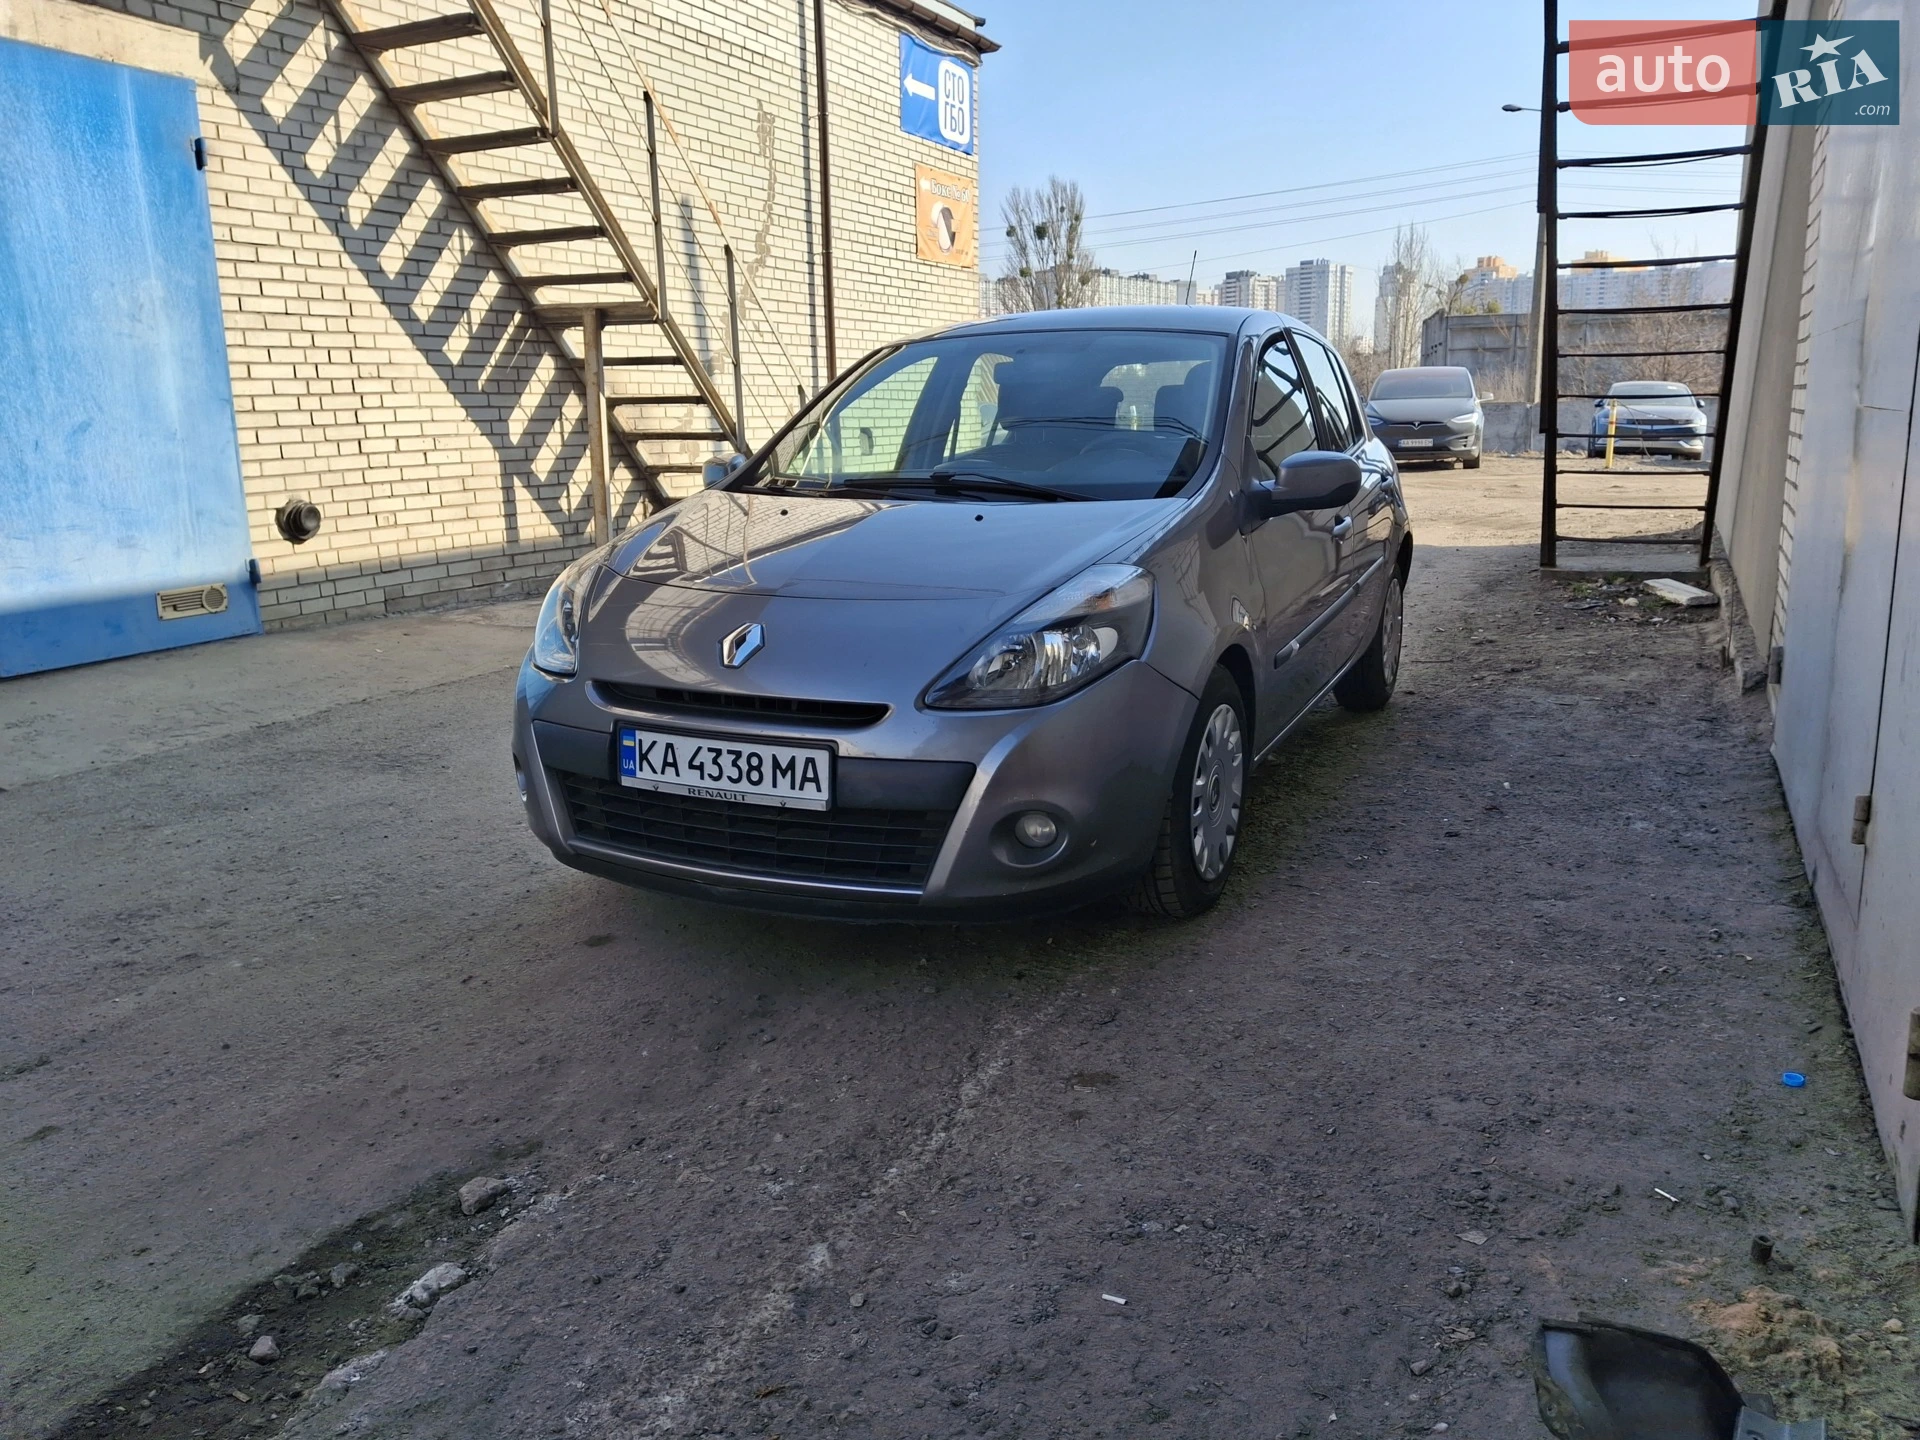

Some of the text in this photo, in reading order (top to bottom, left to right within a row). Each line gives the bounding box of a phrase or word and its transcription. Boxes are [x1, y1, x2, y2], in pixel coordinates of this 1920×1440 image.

[944, 68, 964, 104] СТО
[944, 101, 965, 136] ГБО
[930, 178, 951, 198] Бокс
[622, 759, 636, 770] UA
[638, 738, 823, 793] KA 4338 MA
[688, 787, 748, 802] RENAULT
